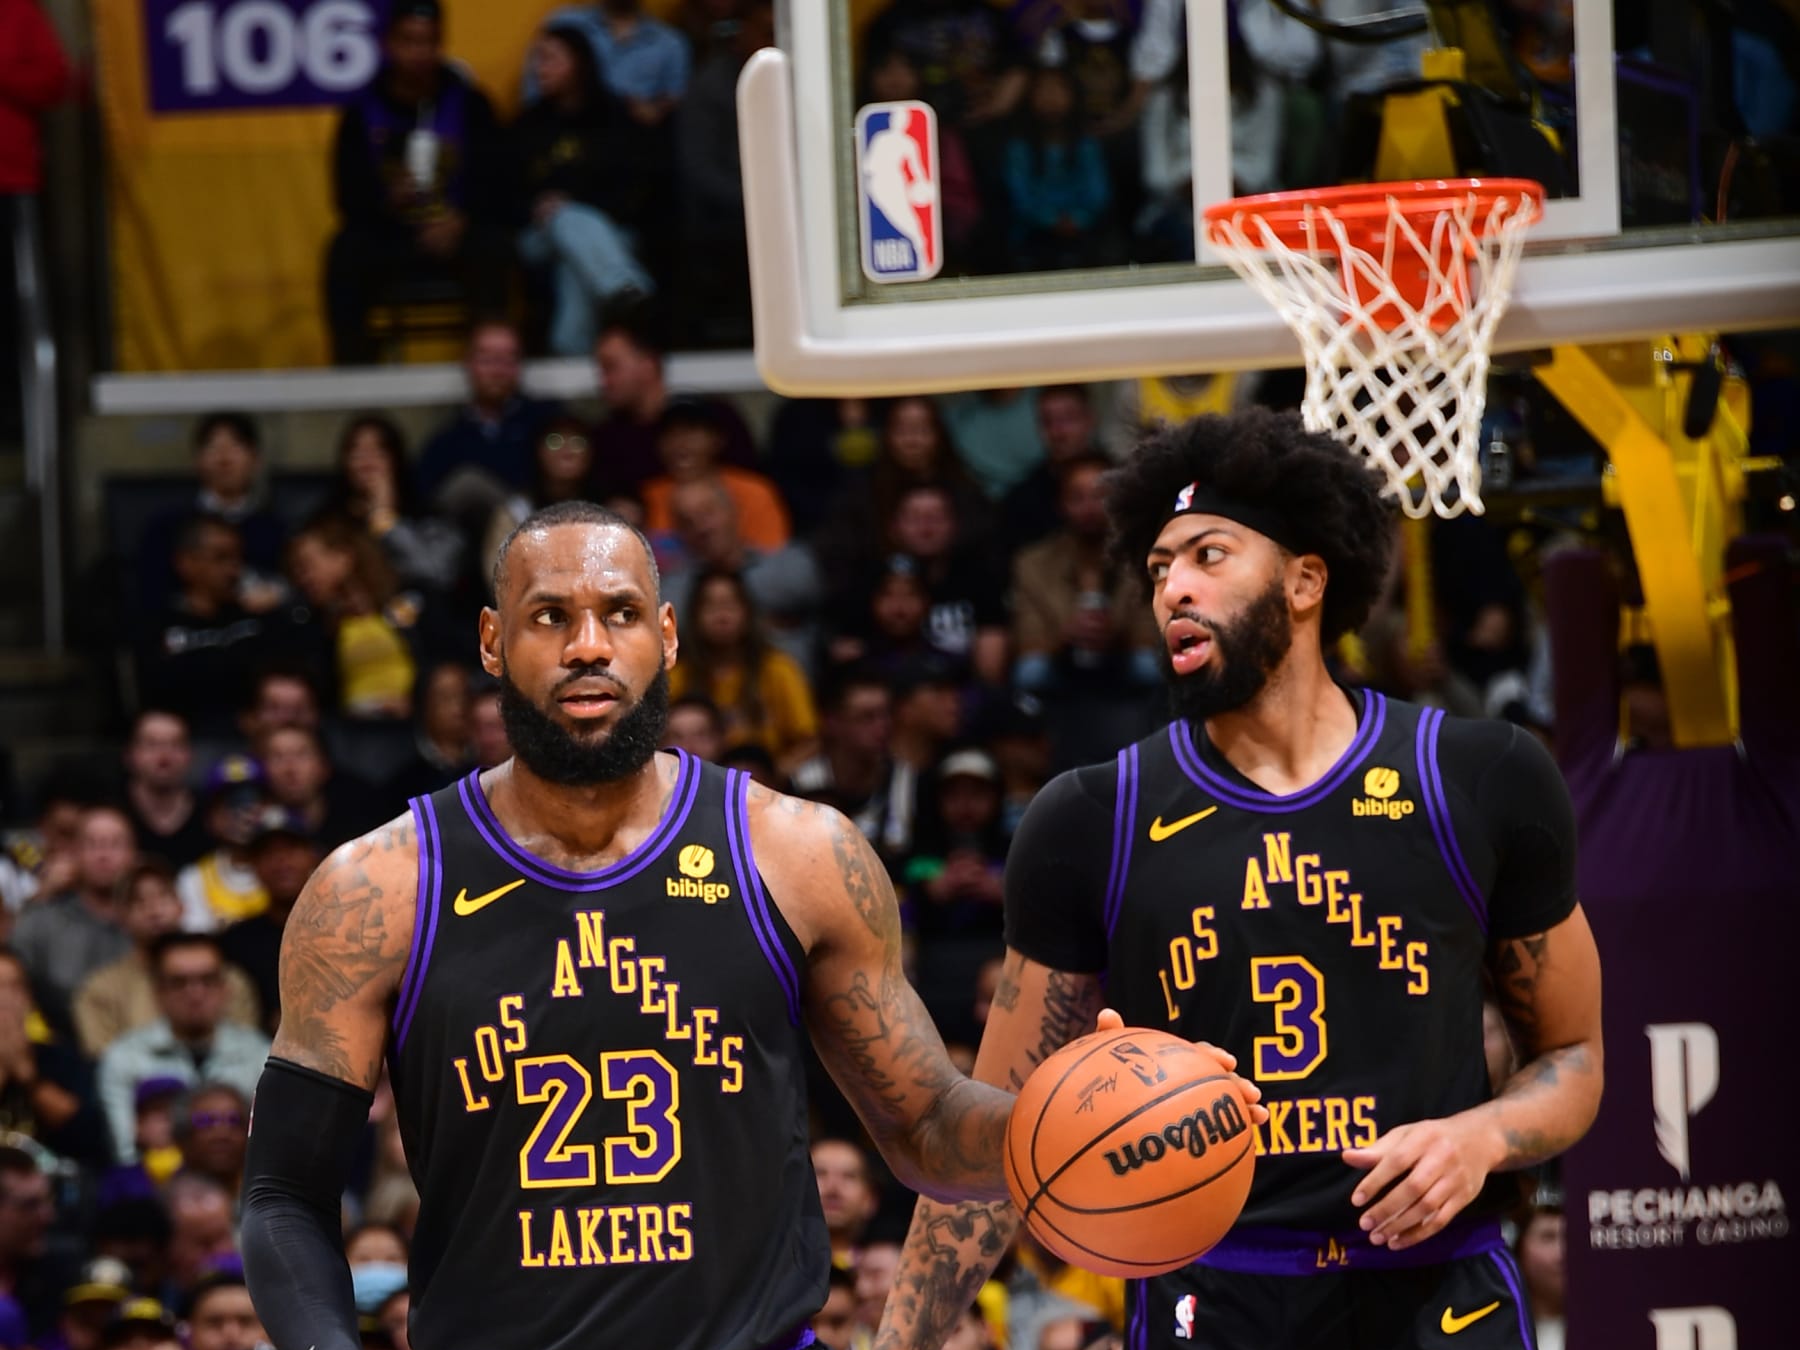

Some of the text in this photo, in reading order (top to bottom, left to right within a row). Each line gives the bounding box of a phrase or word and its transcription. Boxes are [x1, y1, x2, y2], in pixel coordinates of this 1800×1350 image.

[164, 0, 380, 95] 106
[1352, 798, 1415, 820] bibigo
[666, 878, 730, 904] bibigo
[1158, 906, 1219, 1022] LOS
[1241, 832, 1430, 996] ANGELES
[453, 910, 744, 1113] LOS ANGELES
[1250, 955, 1328, 1082] 3
[514, 1049, 681, 1189] 23
[1103, 1093, 1248, 1177] Wilson
[1254, 1095, 1379, 1157] KERS
[517, 1202, 694, 1268] LAKERS
[1588, 1181, 1785, 1225] PECHANGA
[1590, 1217, 1684, 1249] RESORT
